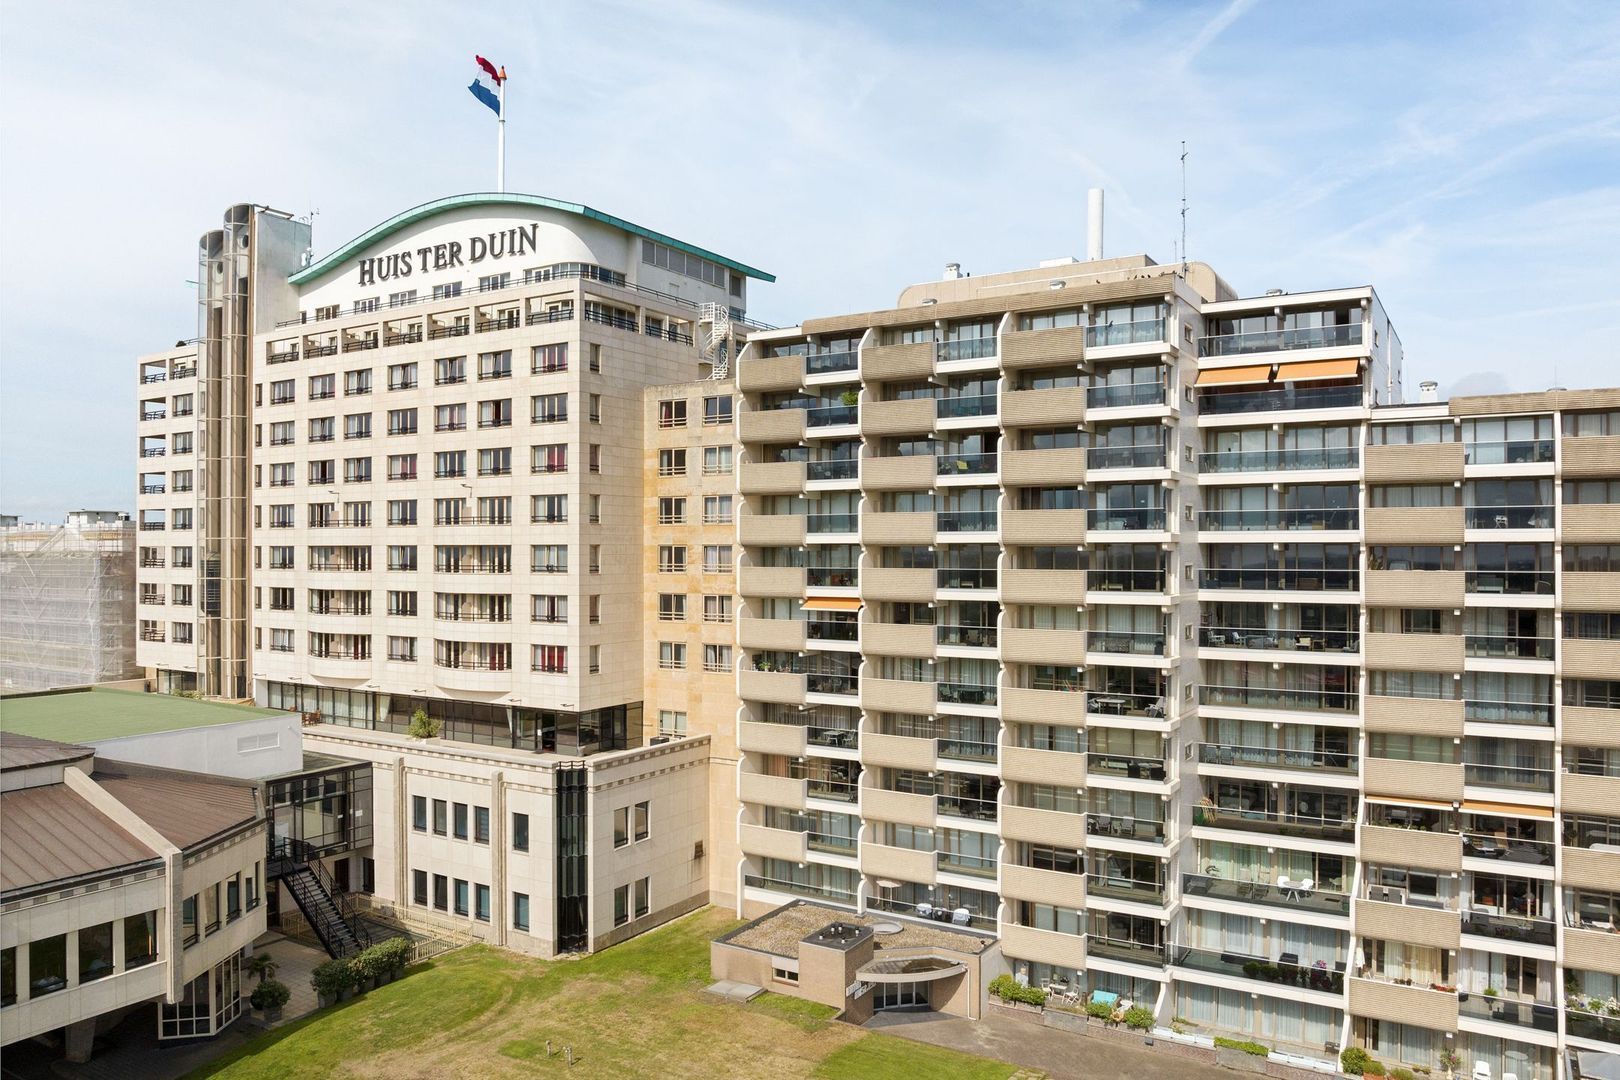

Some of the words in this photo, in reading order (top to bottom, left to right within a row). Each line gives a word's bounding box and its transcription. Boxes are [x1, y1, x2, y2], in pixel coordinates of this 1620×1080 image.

[358, 251, 412, 286] HUIS
[417, 241, 464, 272] TER
[469, 223, 539, 263] DUIN
